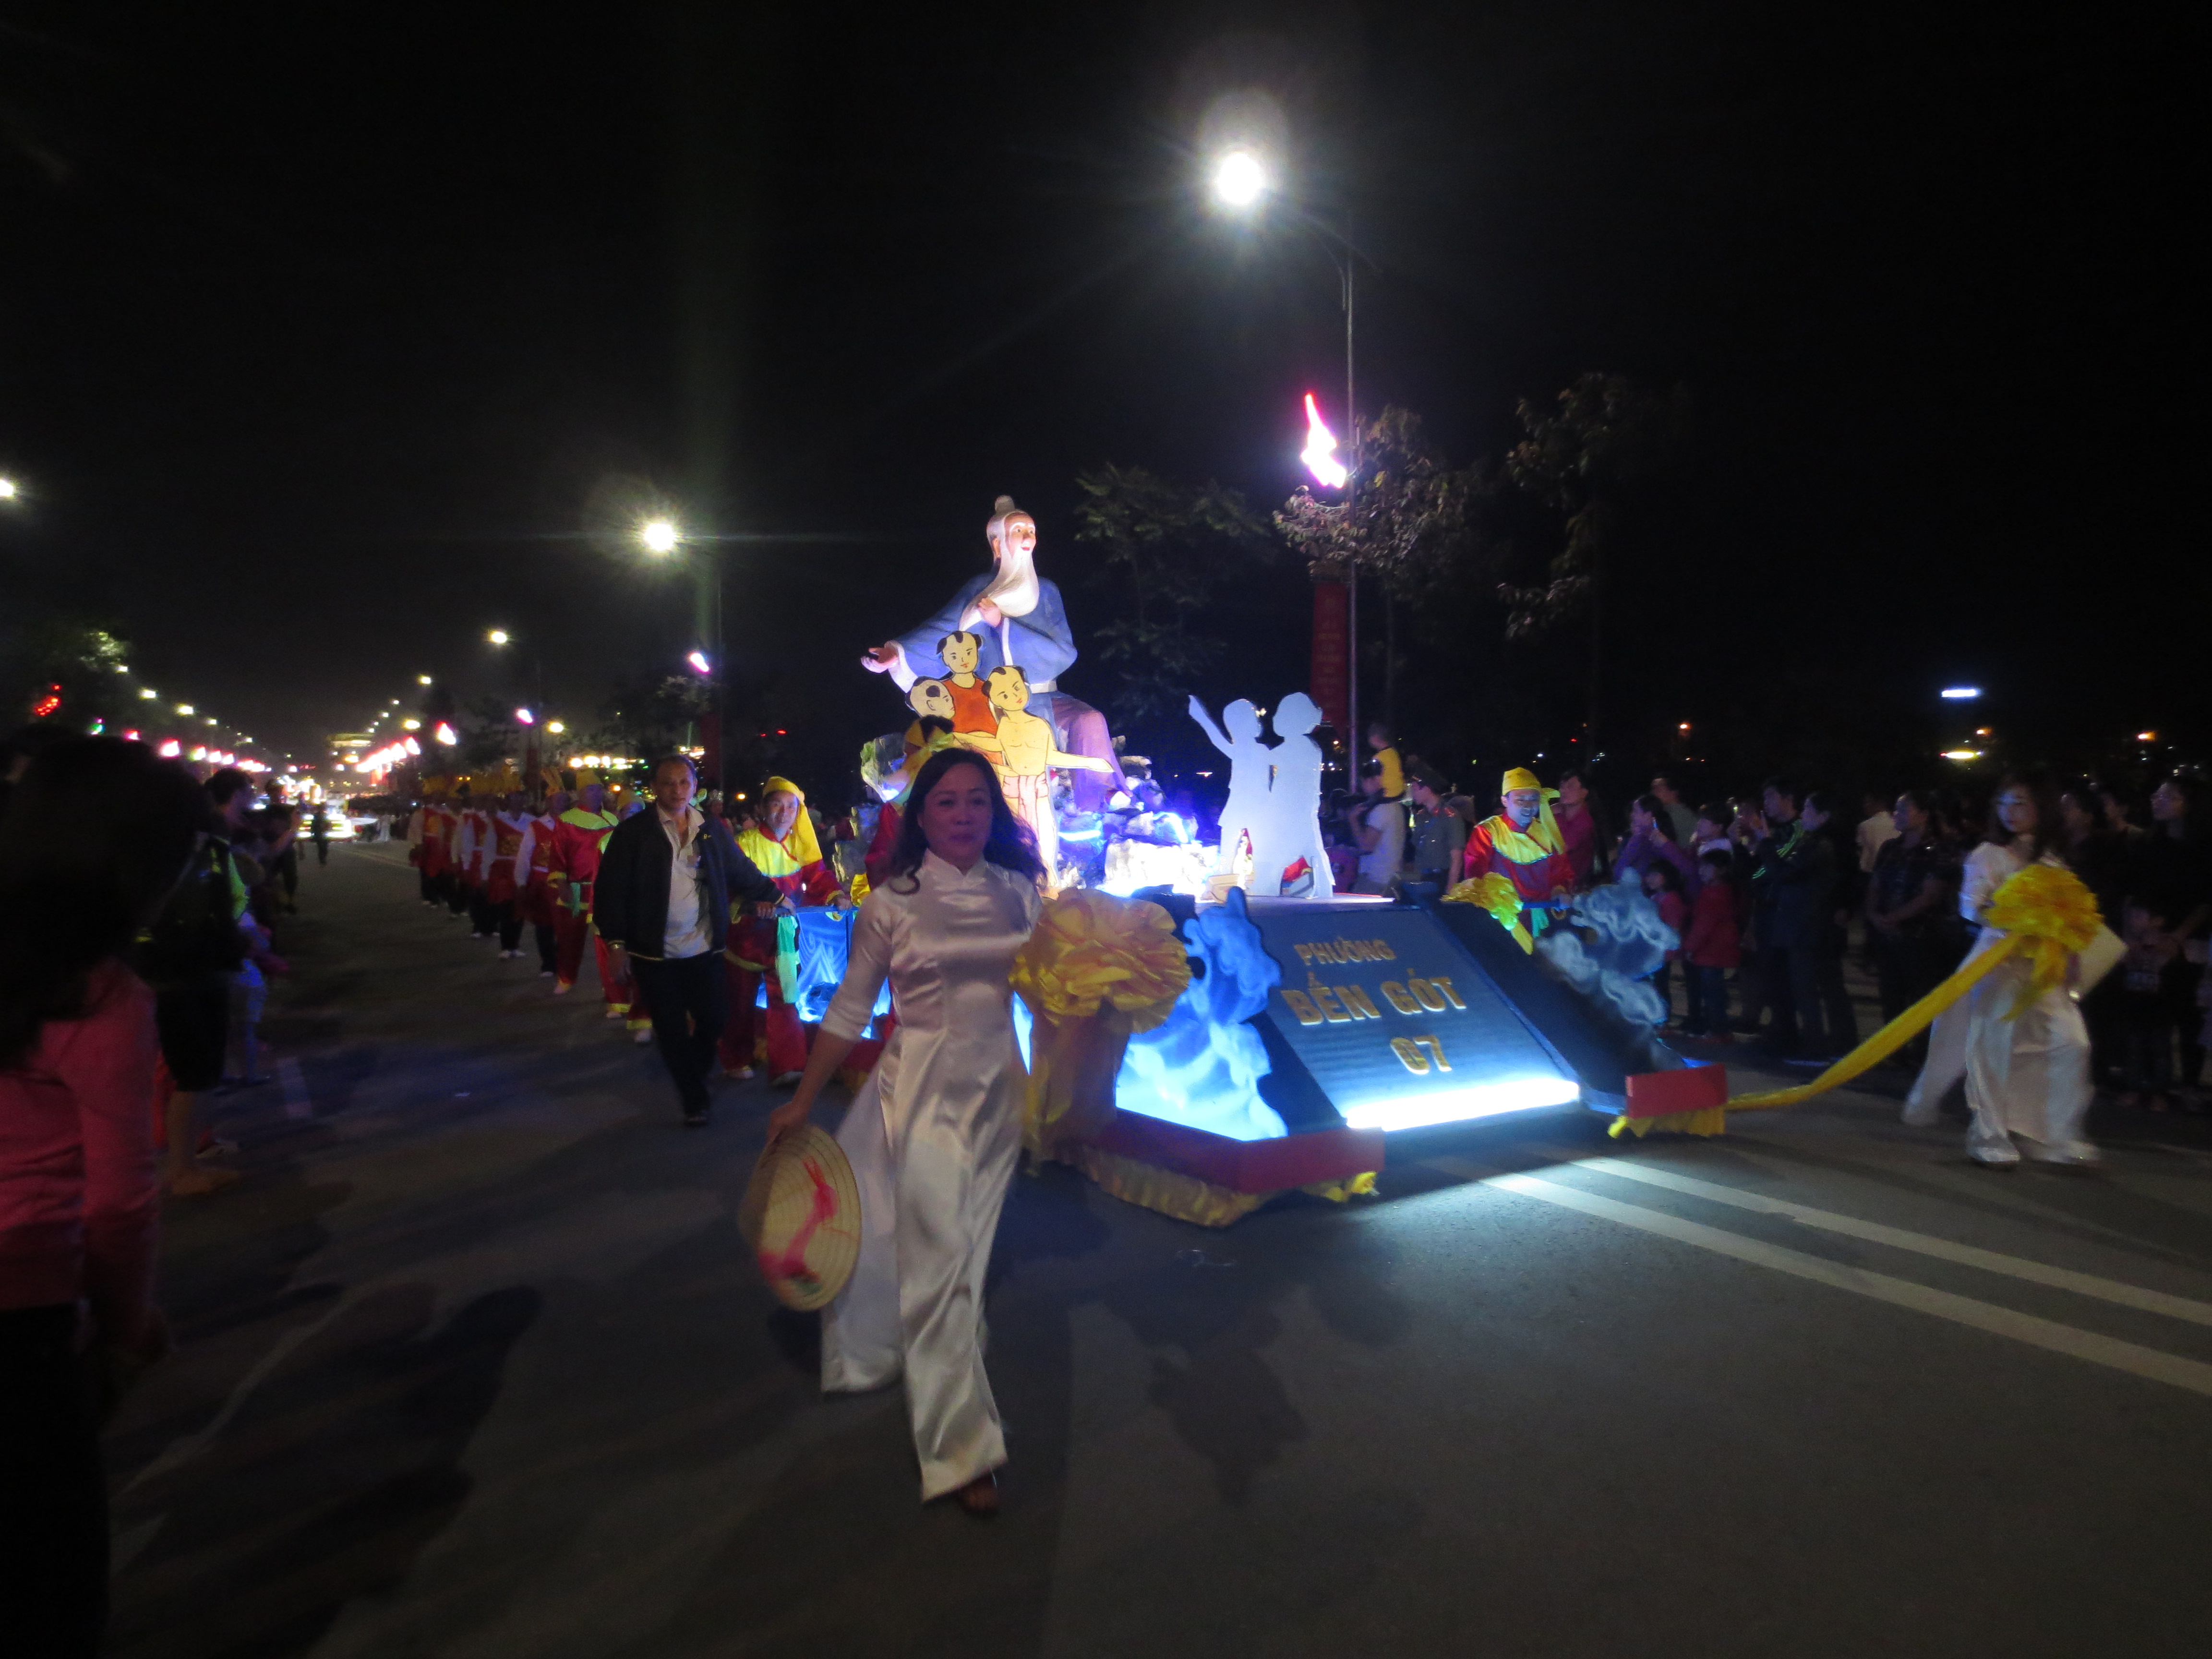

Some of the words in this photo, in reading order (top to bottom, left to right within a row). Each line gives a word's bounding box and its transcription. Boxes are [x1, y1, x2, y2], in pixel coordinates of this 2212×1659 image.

[1280, 971, 1382, 1026] BẾN
[1381, 968, 1467, 1015] GÓT
[1390, 1035, 1452, 1075] 07
